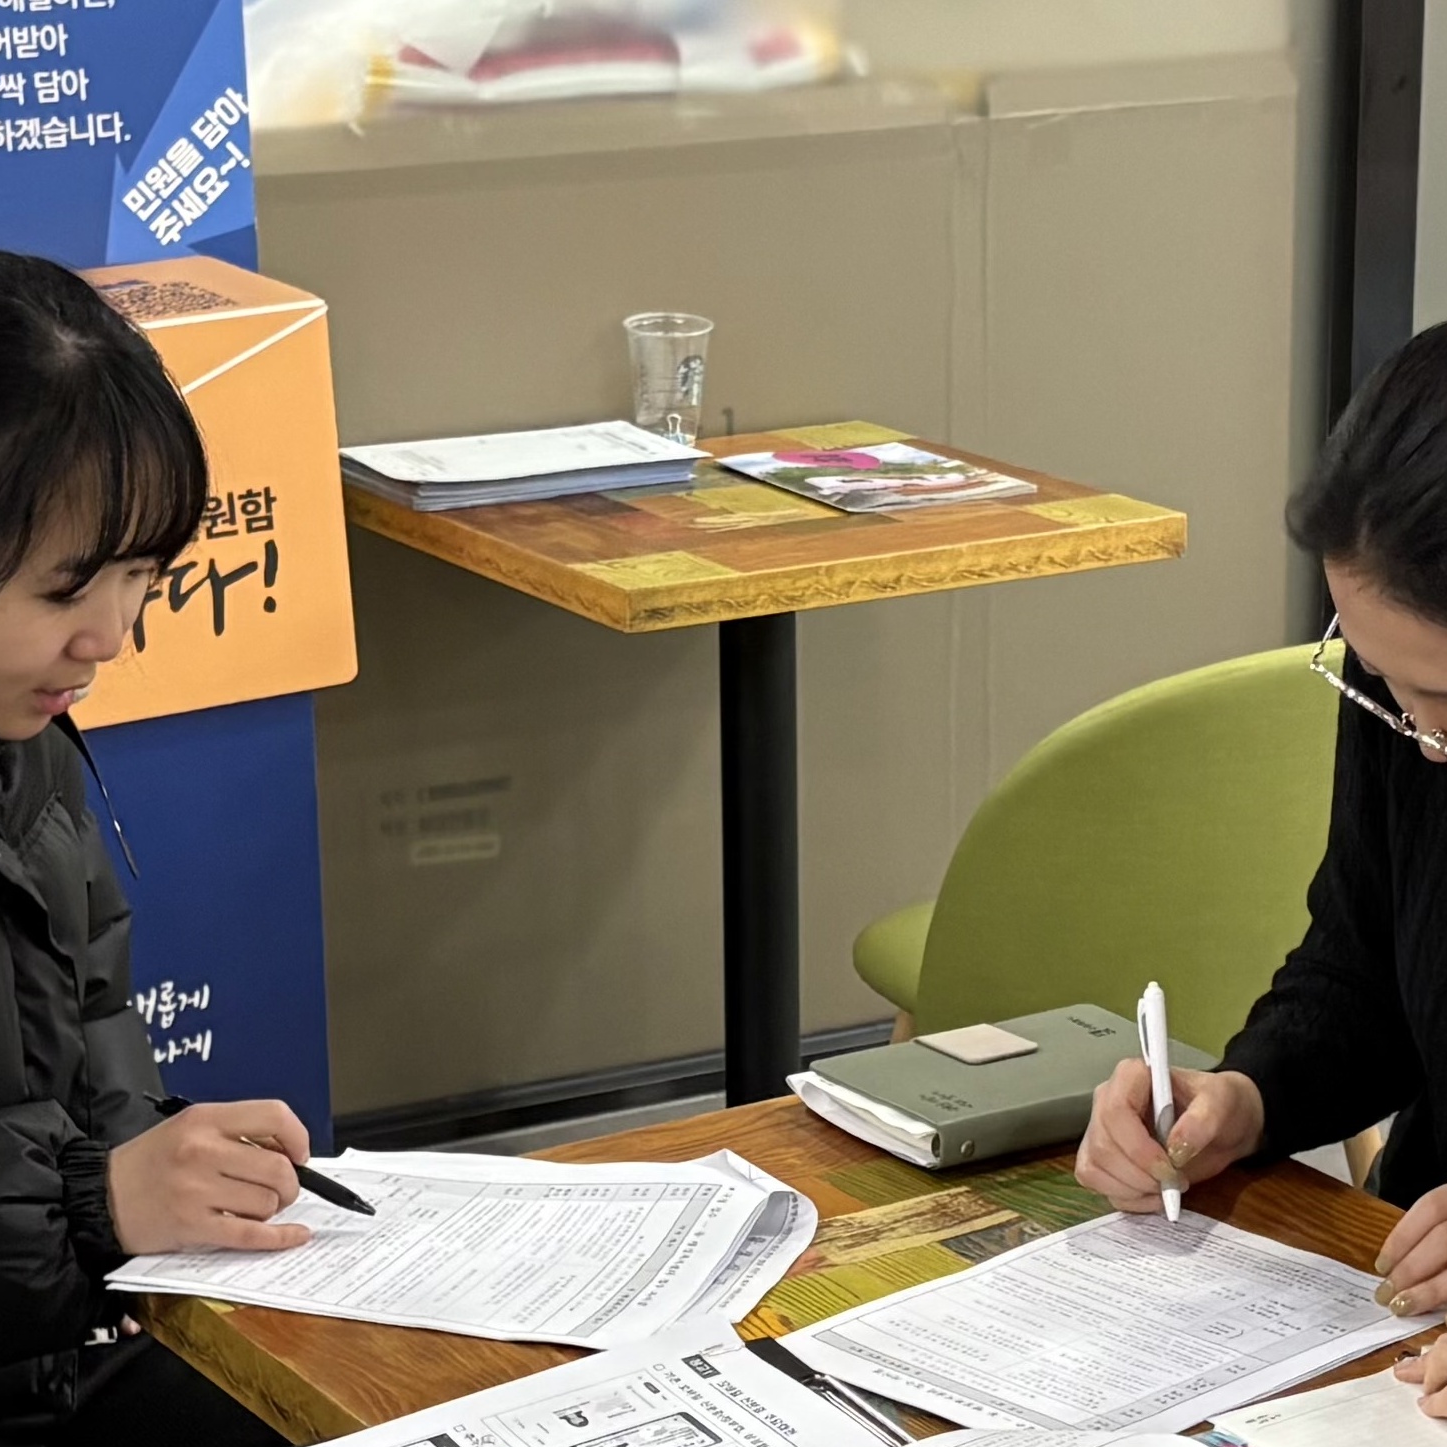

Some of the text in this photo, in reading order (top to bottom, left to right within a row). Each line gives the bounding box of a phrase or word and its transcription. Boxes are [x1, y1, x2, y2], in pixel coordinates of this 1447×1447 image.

[33, 68, 90, 104] 담아
[122, 87, 250, 222] 민원을 담아
[149, 141, 251, 246] 주세요~!
[194, 486, 277, 540] 원함
[133, 539, 279, 653] 다!
[147, 1029, 212, 1064] 나게
